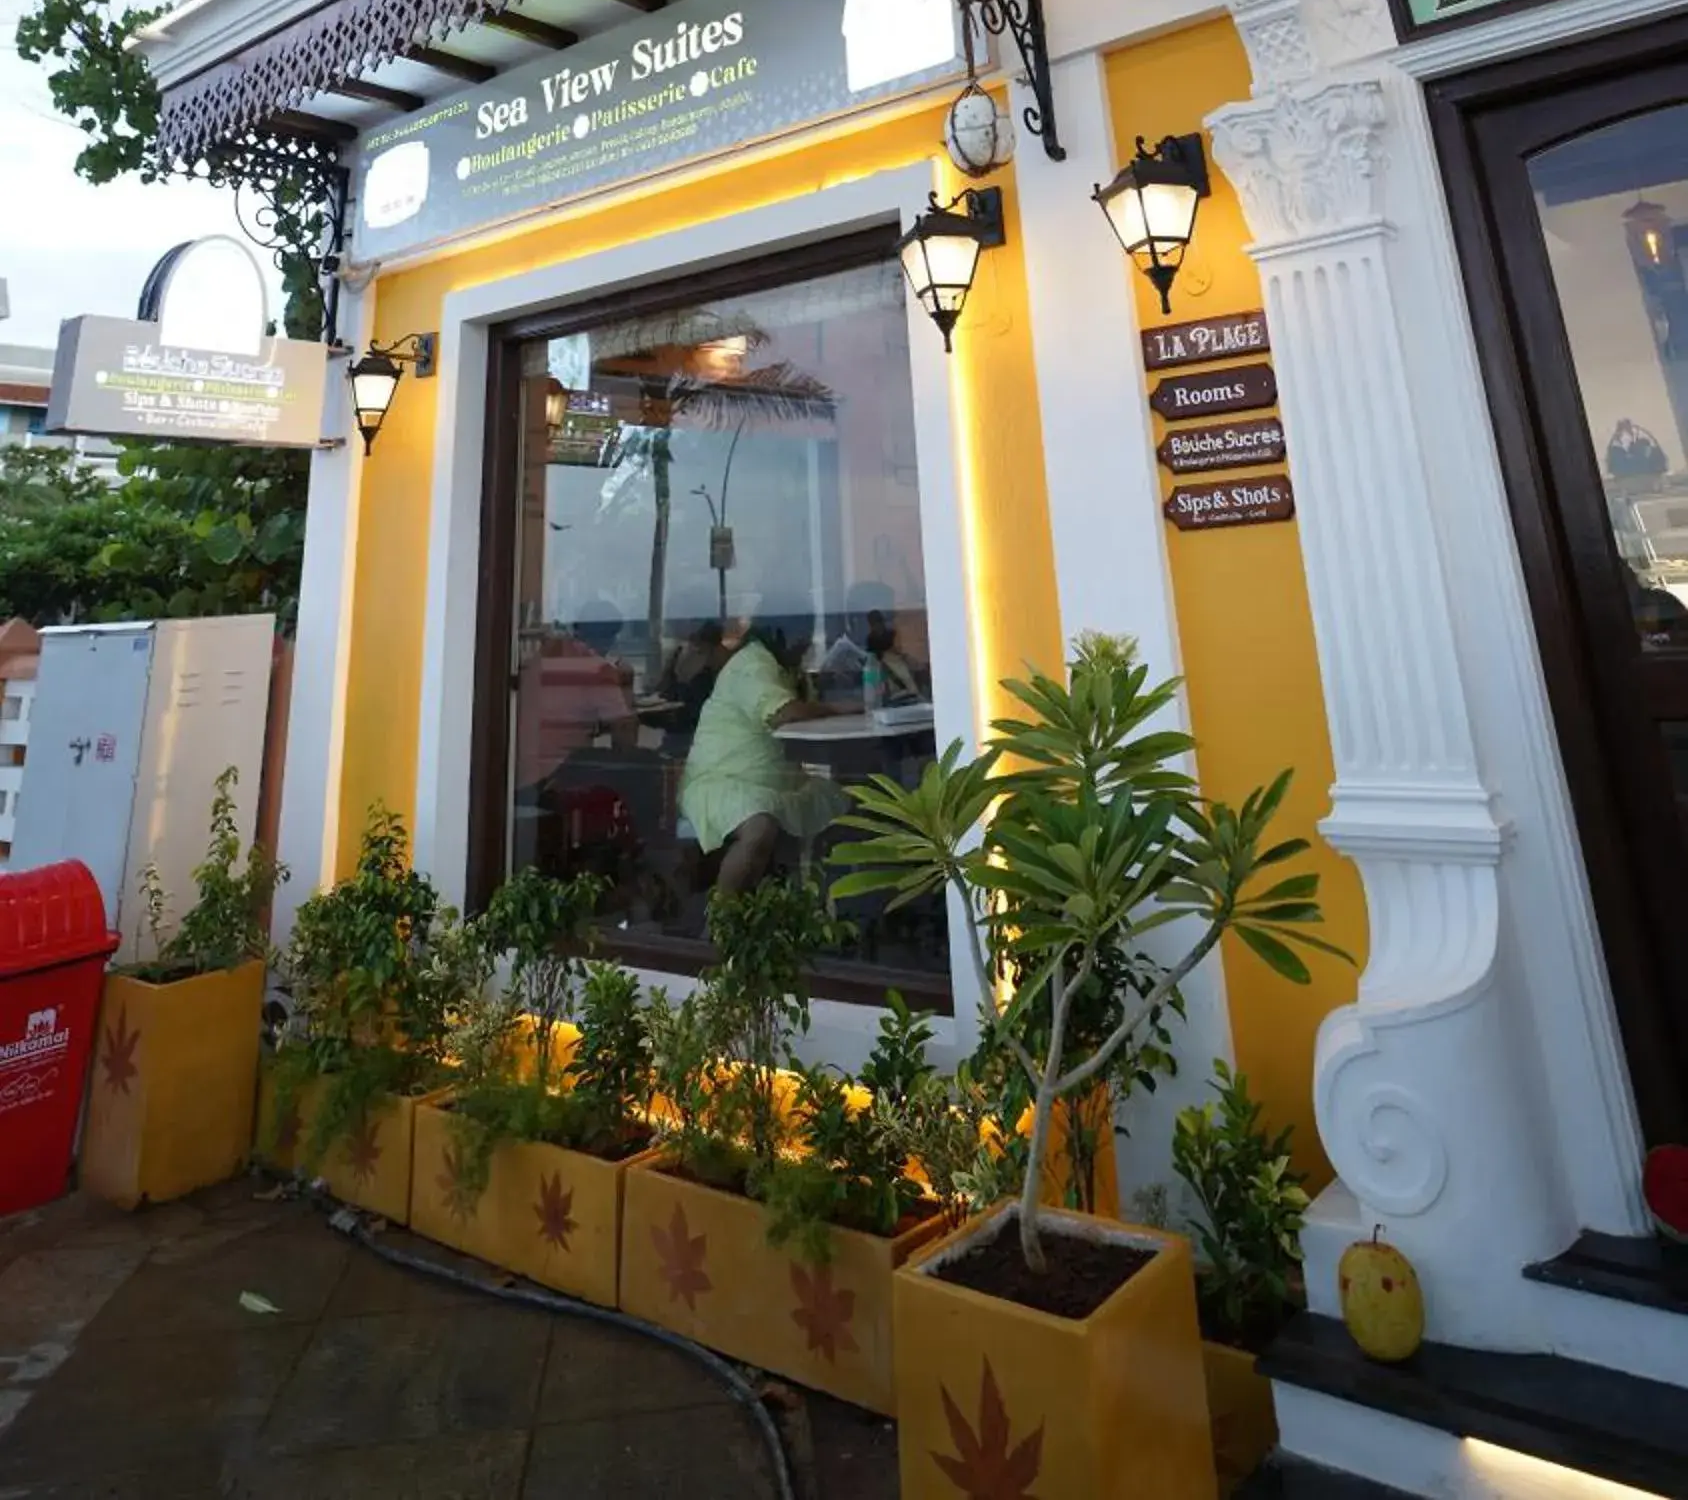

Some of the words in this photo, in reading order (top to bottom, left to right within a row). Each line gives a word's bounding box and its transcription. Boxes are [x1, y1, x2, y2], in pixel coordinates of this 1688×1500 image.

[475, 97, 528, 140] Sea
[541, 58, 619, 113] View
[630, 11, 744, 81] Suites
[590, 80, 686, 131] Patisserie
[1154, 334, 1187, 360] LA
[1190, 321, 1261, 354] PLAGE
[1174, 383, 1245, 407] Rooms
[1231, 485, 1281, 507] Shots
